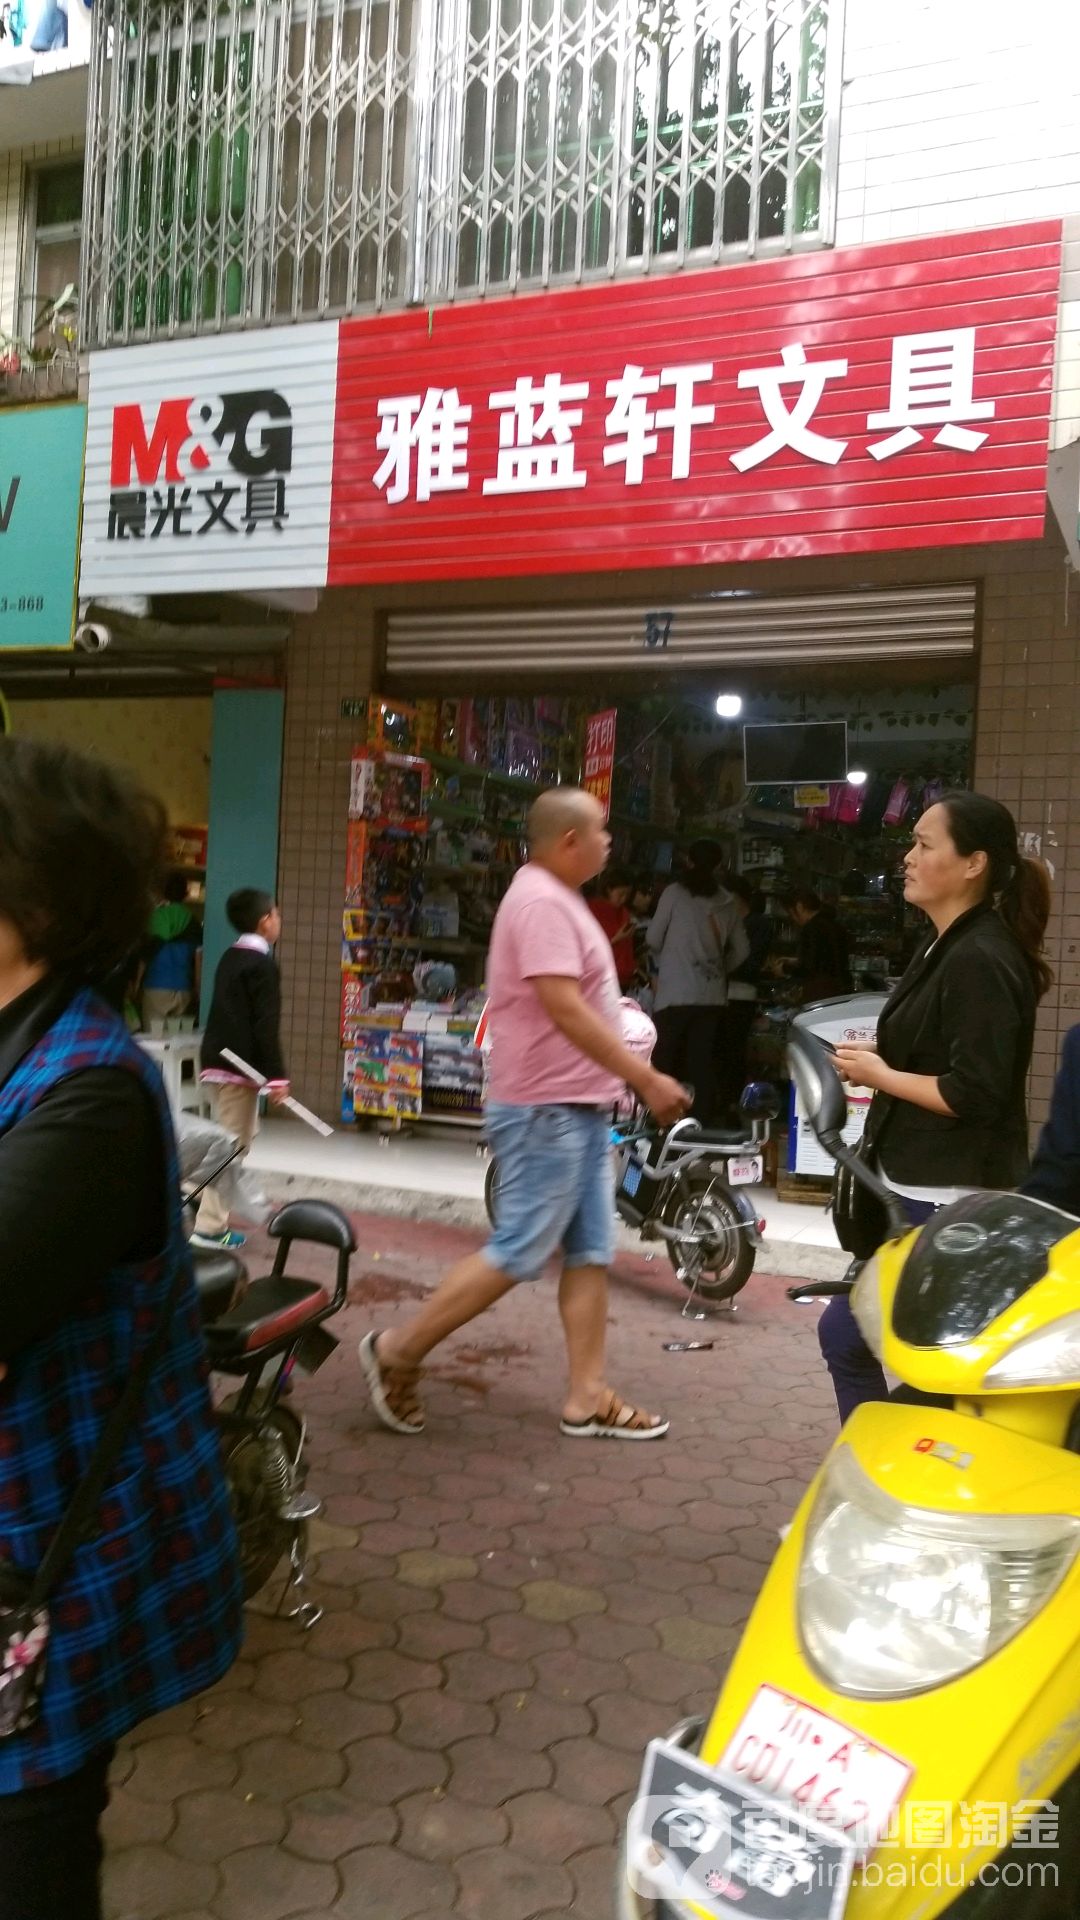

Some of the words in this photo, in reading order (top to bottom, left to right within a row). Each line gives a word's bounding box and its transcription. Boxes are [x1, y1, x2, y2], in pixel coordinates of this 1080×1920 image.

[110, 389, 292, 488] M&G
[372, 327, 995, 504] 雅蓝轩文具
[107, 478, 290, 540] 晨光文具
